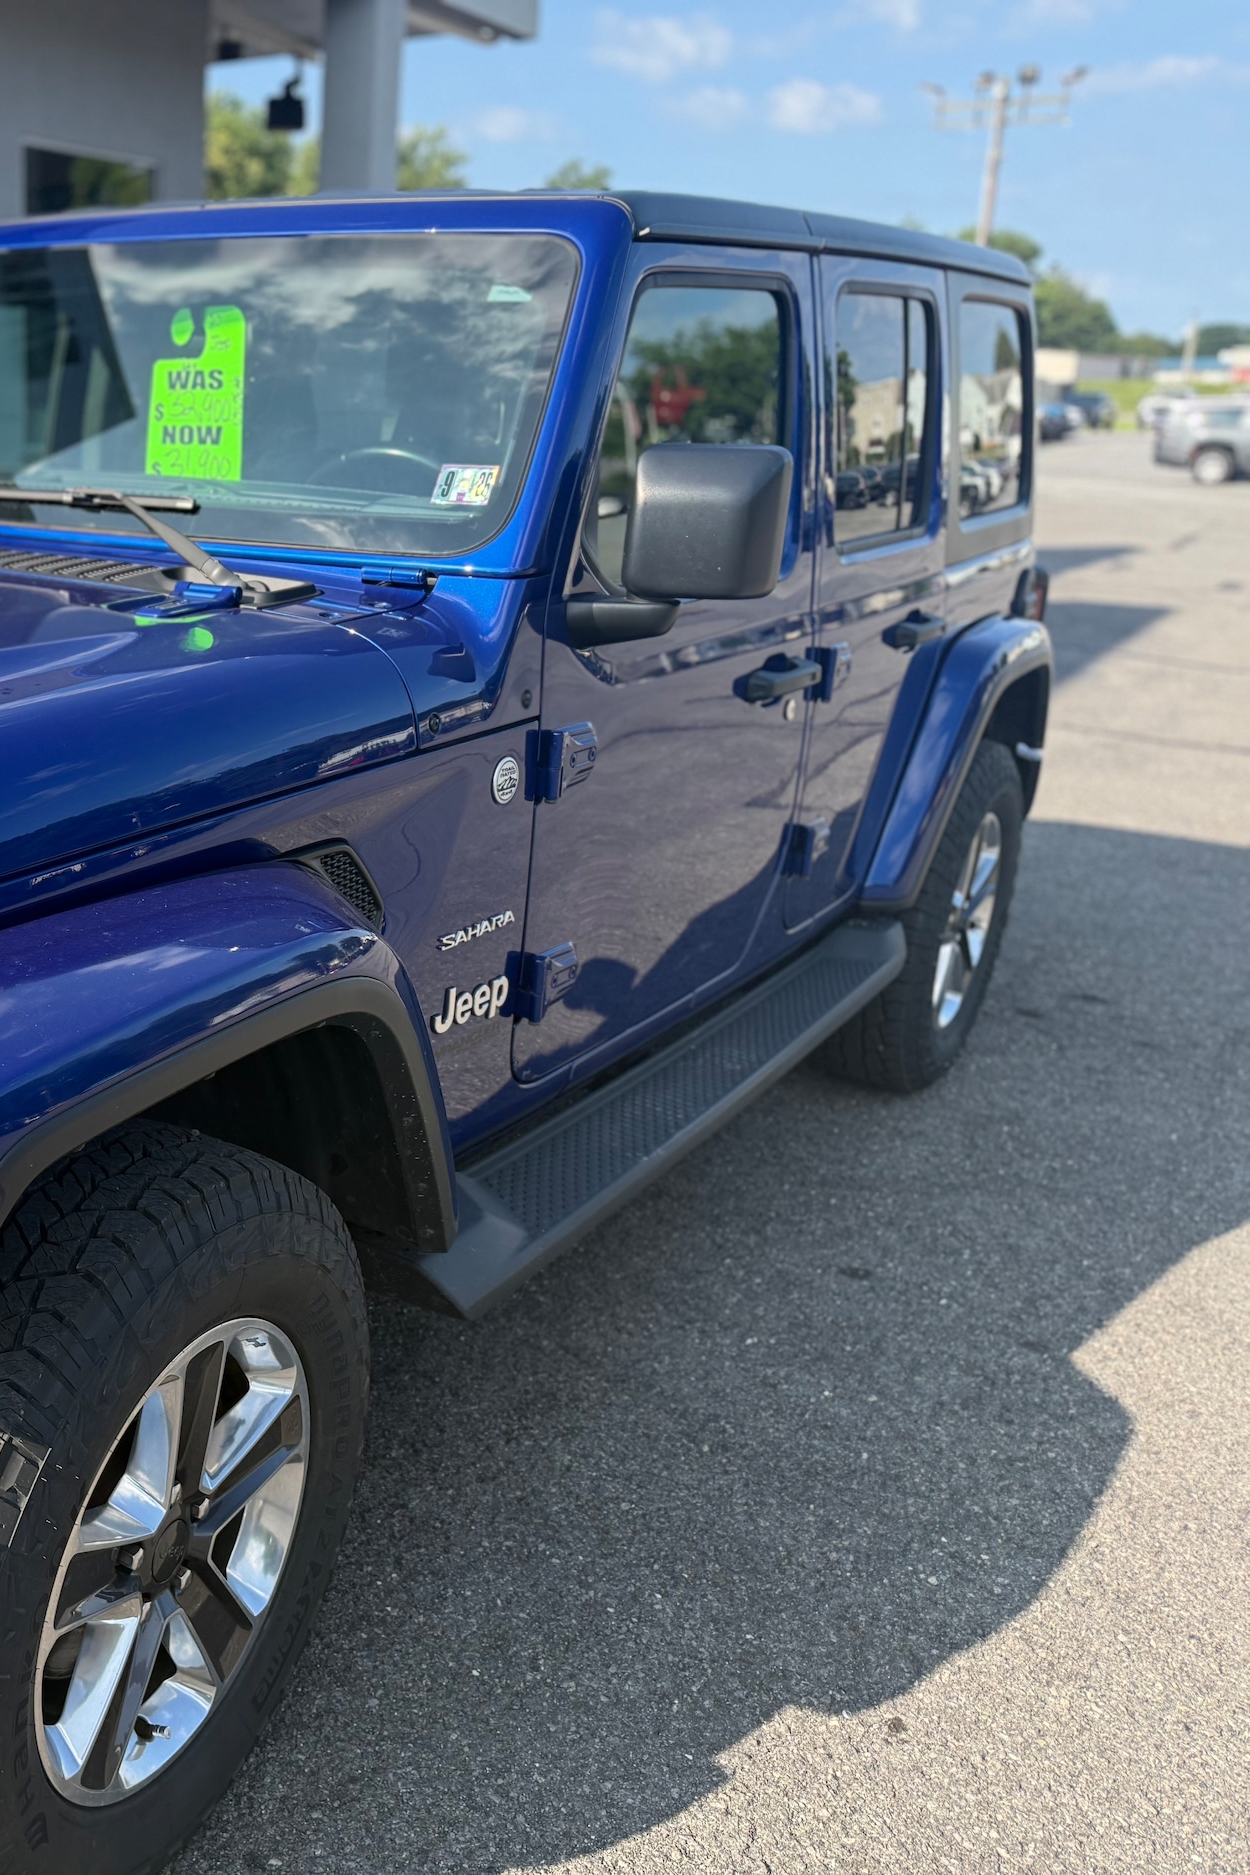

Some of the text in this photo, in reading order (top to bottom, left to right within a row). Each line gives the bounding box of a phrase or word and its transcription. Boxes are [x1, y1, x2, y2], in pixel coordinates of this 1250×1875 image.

[167, 369, 225, 392] WAS
[161, 425, 224, 446] NOW
[441, 470, 456, 498] 9
[437, 909, 516, 952] SAHARA
[430, 974, 510, 1035] Jeep
[434, 1021, 502, 1058] WRANGLER
[158, 1544, 186, 1562] Jeep
